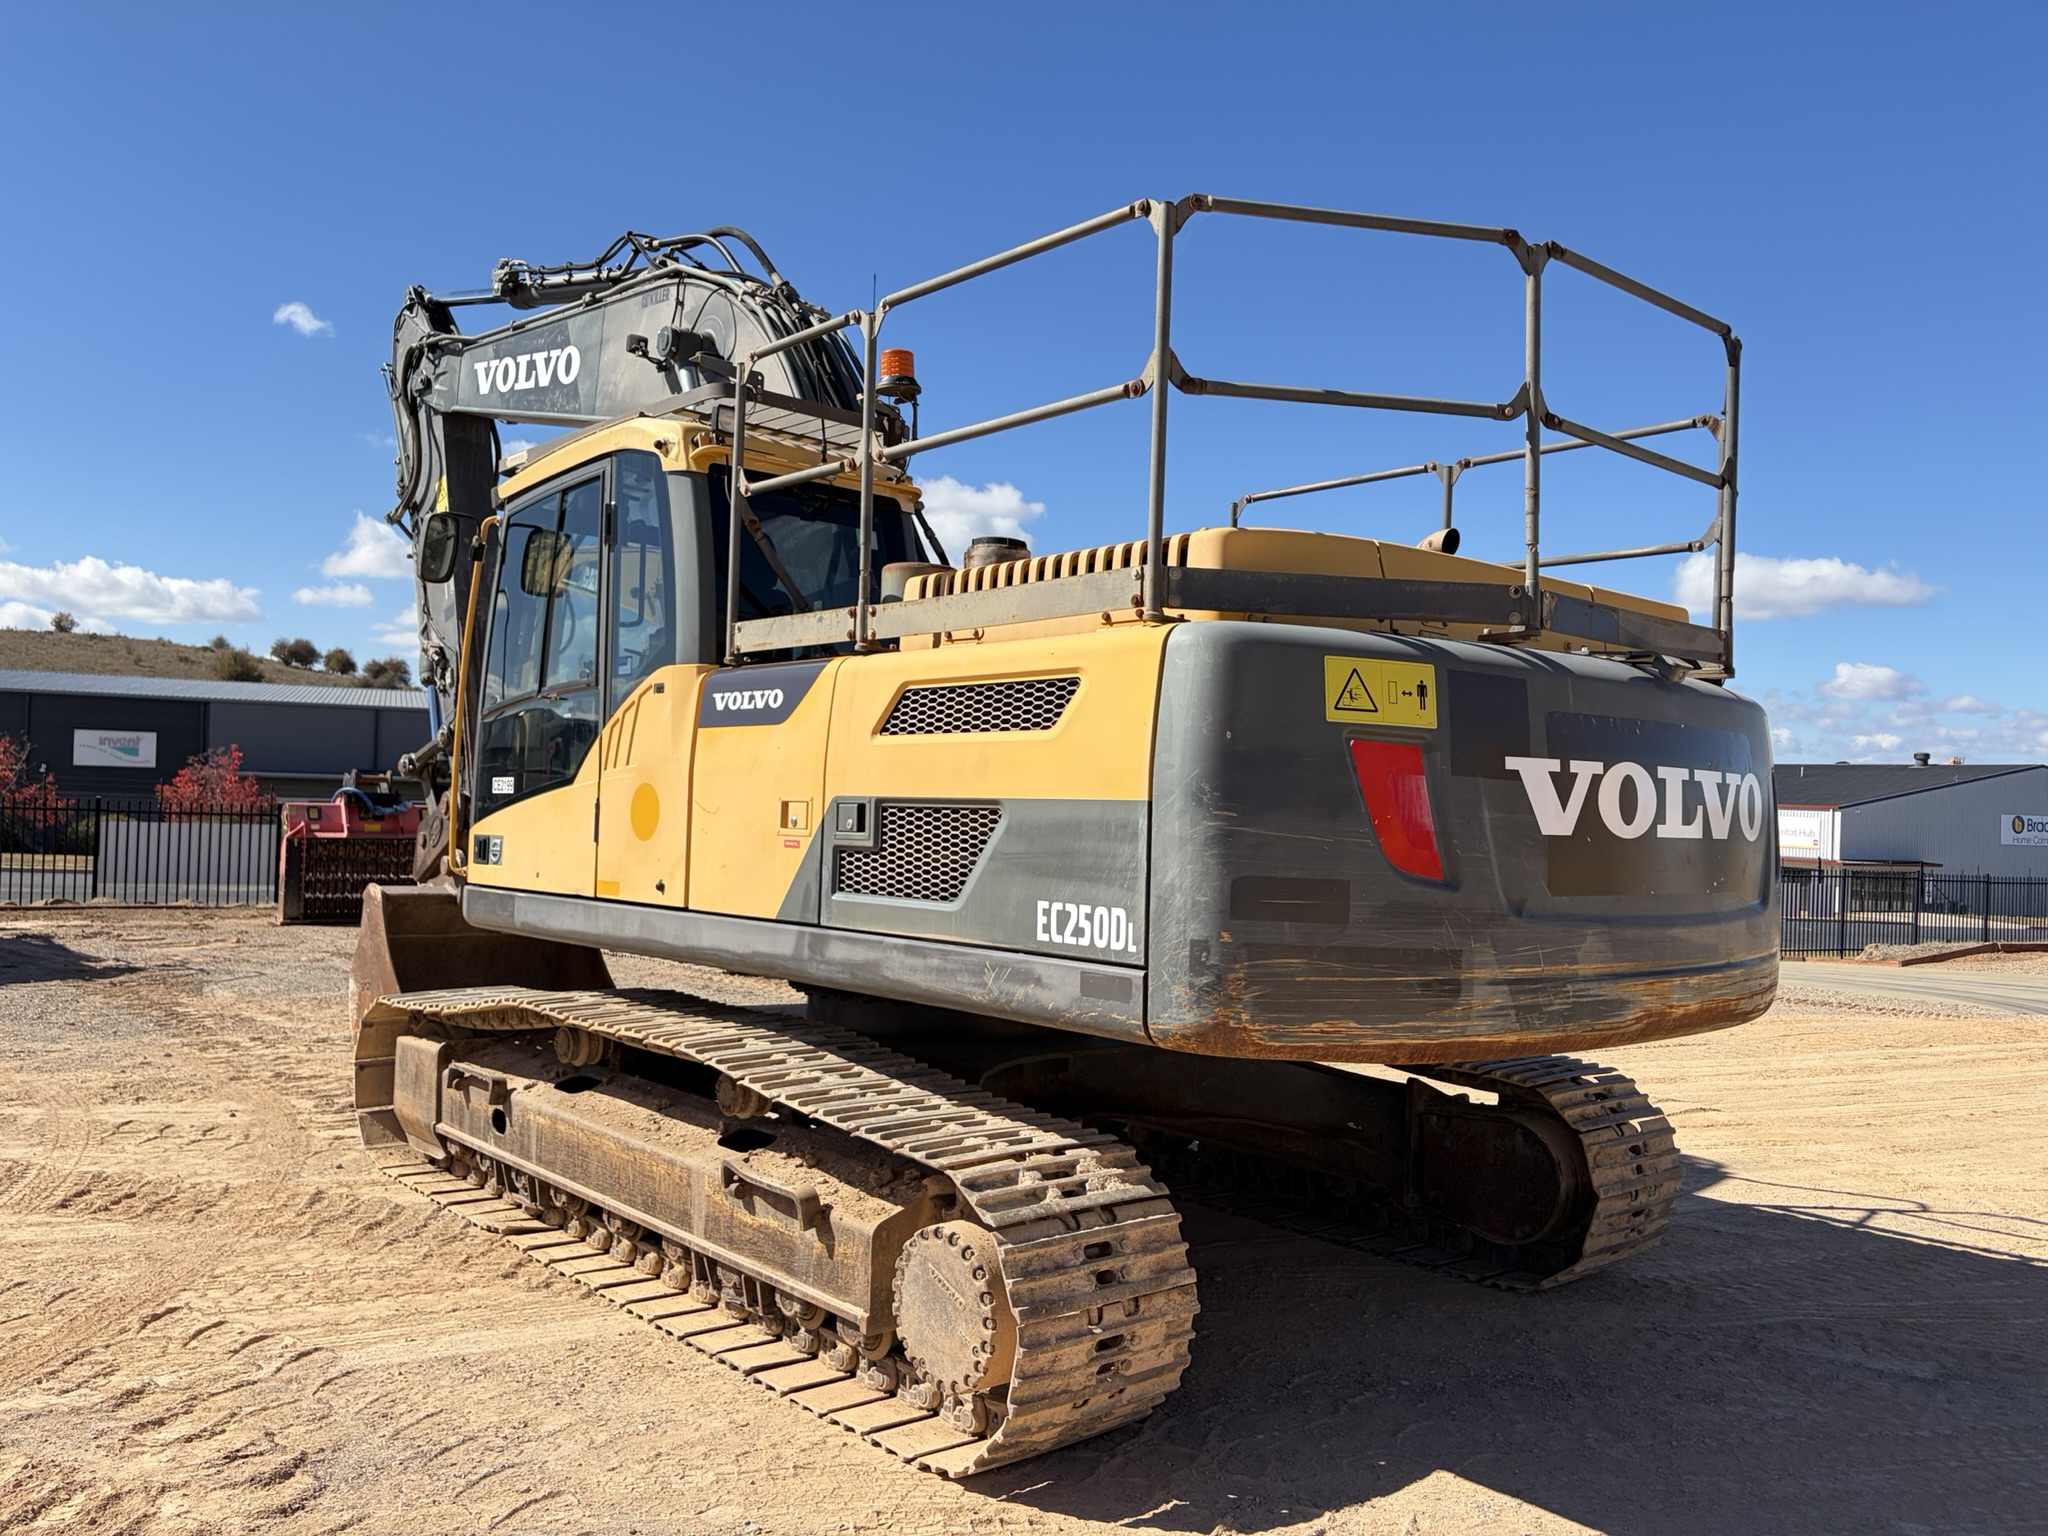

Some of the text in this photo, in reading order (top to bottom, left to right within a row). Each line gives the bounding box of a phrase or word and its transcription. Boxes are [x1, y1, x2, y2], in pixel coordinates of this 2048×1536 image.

[474, 345, 580, 395] VOLVO
[712, 688, 784, 711] VOLVO
[1505, 756, 1762, 842] VOLVO
[1799, 829, 1816, 838] Hub
[2012, 835, 2031, 844] Home
[1037, 900, 1137, 953] EC250DL
